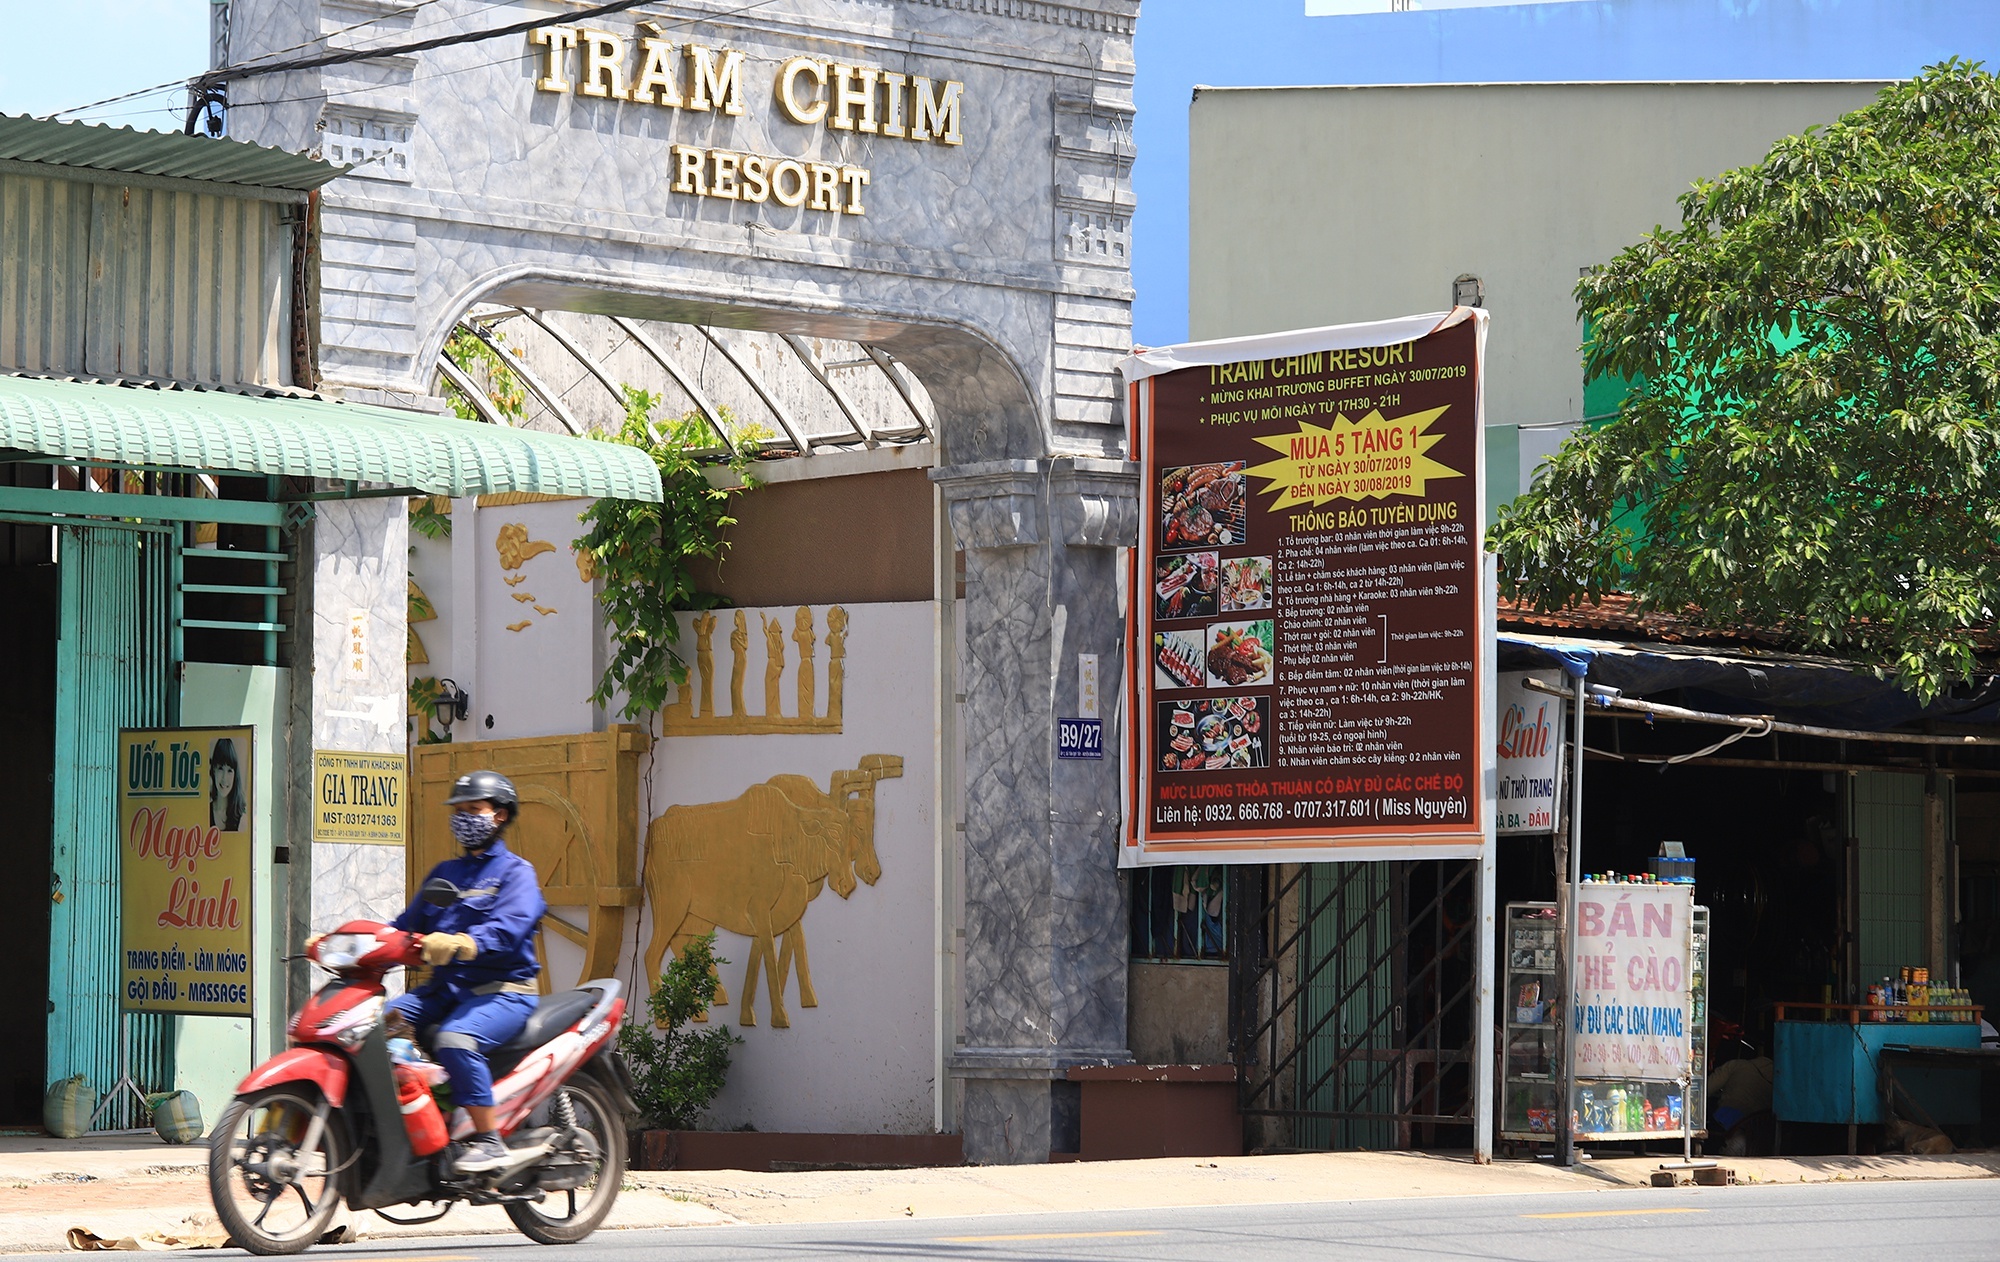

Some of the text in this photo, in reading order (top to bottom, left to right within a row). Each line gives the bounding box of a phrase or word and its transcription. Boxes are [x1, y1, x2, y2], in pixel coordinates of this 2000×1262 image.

[530, 20, 963, 145] TRÀM CHIM
[670, 144, 870, 215] RESORT
[1271, 351, 1322, 378] CHIM
[1330, 340, 1417, 371] RESORT
[1211, 365, 1466, 404] MỪNG KHAI TRƯƠNG BUFFET NGÀY 30/07/2019
[1211, 412, 1240, 426] PHỤC
[1243, 410, 1257, 423] VỤ
[1285, 401, 1316, 417] NGÀY
[1319, 399, 1335, 413] TỪ
[1337, 398, 1369, 411] 17H30
[1380, 394, 1400, 407] 21H
[1291, 426, 1416, 460] MUA 5 TẶNG 1
[1299, 456, 1411, 478] TỪ NGÀY 30/07/2019
[1291, 475, 1411, 498] ĐẾN NGÀY 30/08/2019
[1289, 502, 1457, 532] THÔNG BÁO TUYỂN DỤNG
[1335, 533, 1343, 542] 03
[1441, 523, 1464, 533] 9h-22h
[1361, 682, 1370, 690] 10
[1060, 723, 1101, 749] B9/27
[1385, 716, 1411, 726] 9h-22h
[1497, 701, 1551, 759] Linh
[1309, 732, 1330, 742] 19-25,
[128, 740, 200, 790] Uốn Tóc
[319, 756, 334, 767] CÔNG
[336, 759, 342, 767] TY
[344, 759, 357, 768] TNHH
[372, 758, 389, 770] KHÁCH
[391, 762, 402, 772] SẠN
[1278, 758, 1288, 766] 10.
[323, 773, 398, 807] GIA TRANG
[1161, 783, 1186, 799] MỨC
[1190, 784, 1233, 799] LƯƠNG
[1236, 780, 1269, 796] THỎA
[1271, 779, 1312, 797] THUẬN
[1315, 777, 1334, 794] CÓ
[1364, 775, 1382, 792] ĐỦ
[1385, 774, 1411, 791] CÁC
[1444, 774, 1463, 792] ĐỘ
[1499, 774, 1552, 800] NỮ THỜI TRANG
[323, 812, 397, 826] MST:0312741363
[1157, 806, 1180, 822] Liên
[1185, 805, 1201, 826] hệ:
[1206, 804, 1235, 821] 0932.
[1239, 802, 1283, 820] 666.768
[1294, 799, 1369, 818] 0707.317.601
[1383, 799, 1411, 815] Miss
[1415, 797, 1467, 819] Nguyên)
[1508, 814, 1520, 827] BA
[1529, 806, 1550, 827] ĐẦM
[130, 807, 221, 872] Ngọc
[158, 876, 241, 929] Linh
[1578, 893, 1672, 938] BÁN
[127, 950, 158, 971] TRANG
[161, 943, 185, 971] ĐIỂM
[194, 947, 213, 972] LÀM
[217, 948, 247, 973] MÓNG
[1627, 946, 1681, 992] CÀO
[128, 977, 148, 1006] GỘI
[152, 974, 176, 1001] ĐẦU
[188, 983, 247, 1004] MASSAGE
[1587, 994, 1601, 1034] ĐỦ
[1604, 998, 1623, 1034] CÁC
[1627, 1006, 1649, 1041] LOẠI
[1652, 1007, 1682, 1042] MẠNG
